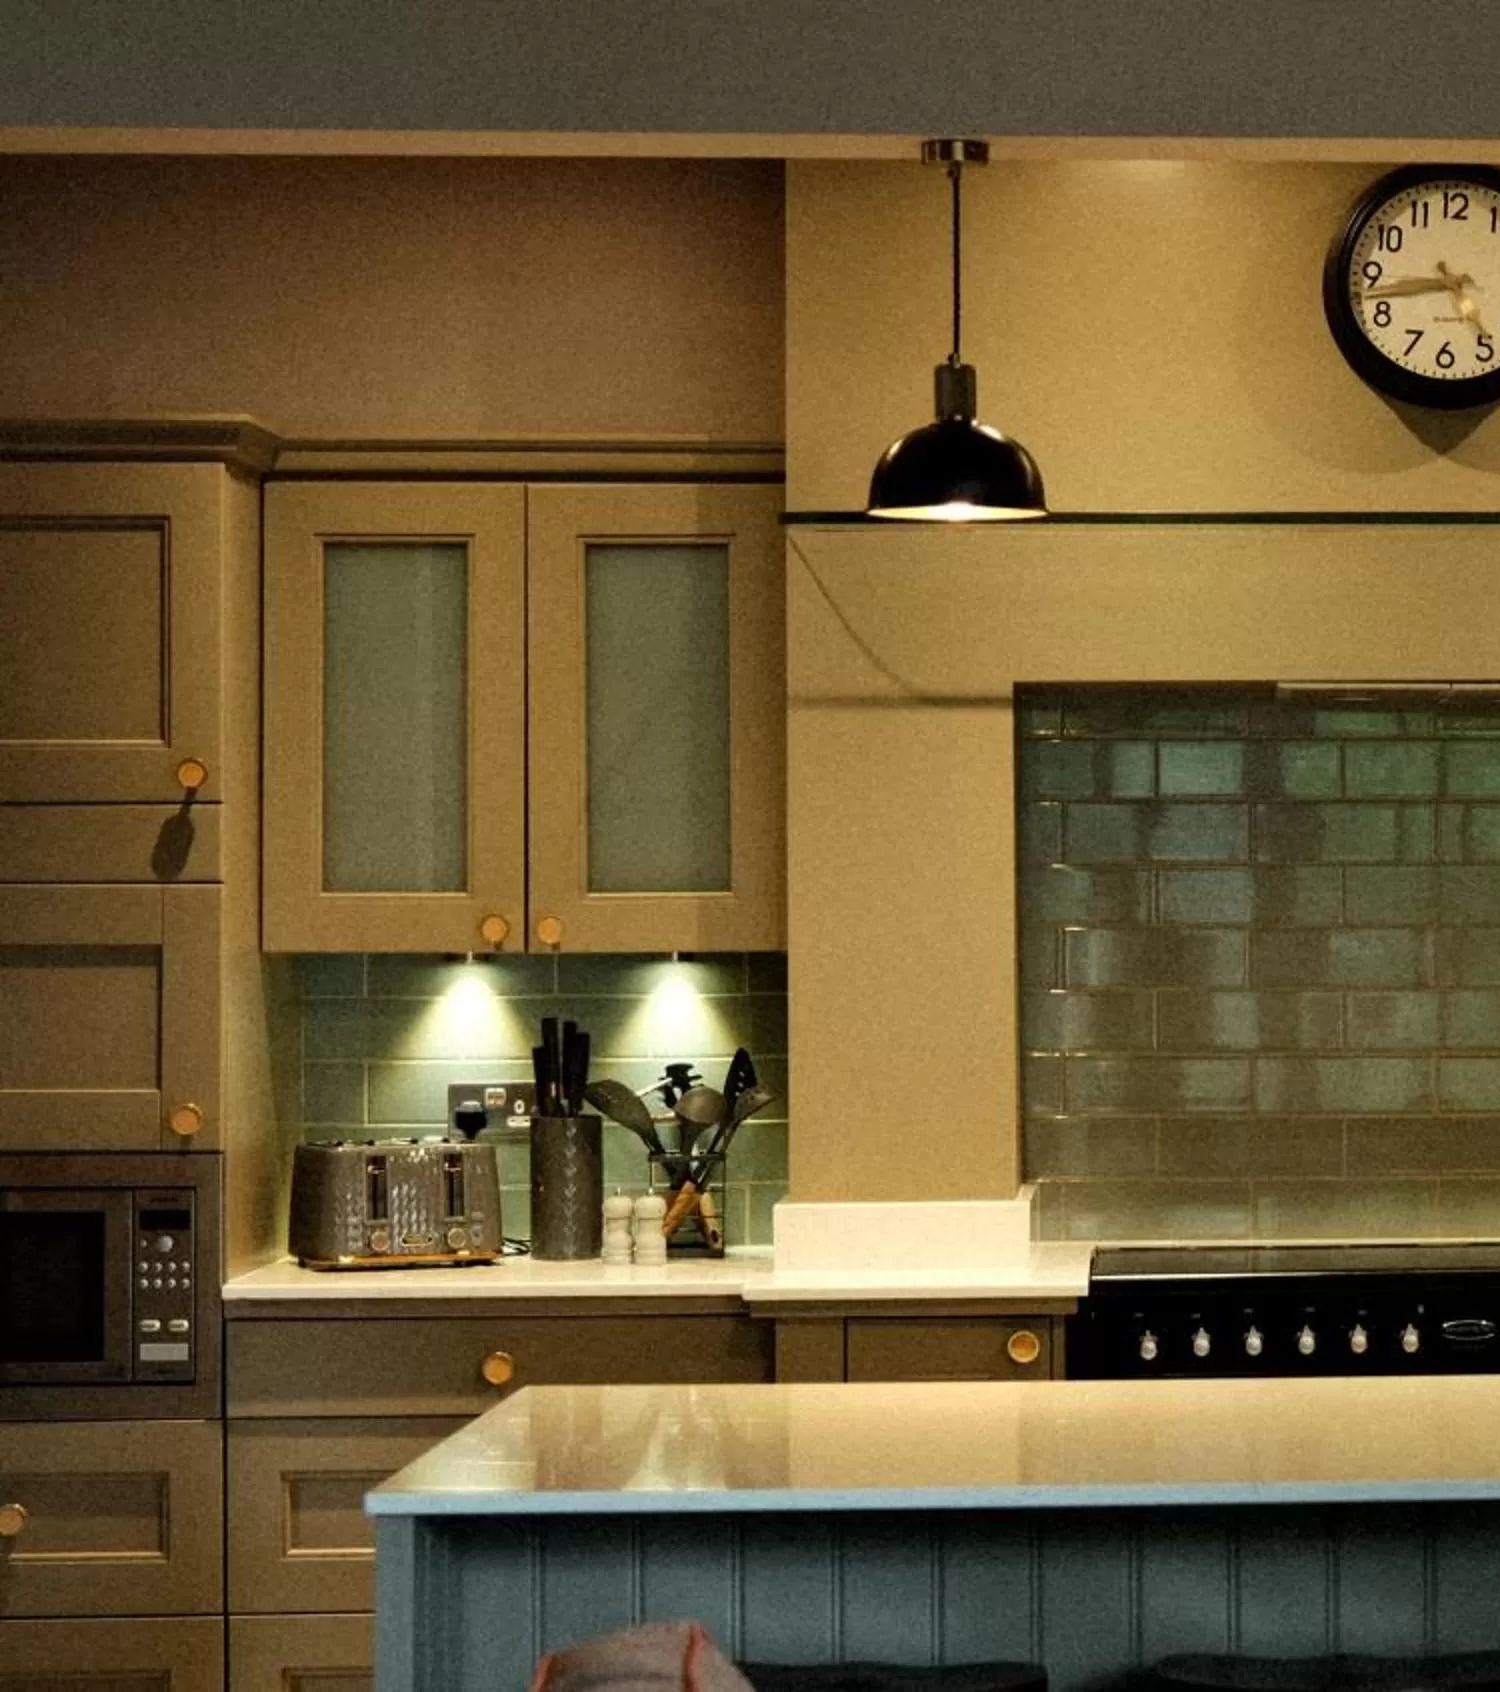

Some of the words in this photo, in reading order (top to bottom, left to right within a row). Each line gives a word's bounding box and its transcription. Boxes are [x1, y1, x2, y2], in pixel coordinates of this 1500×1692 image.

[1411, 201, 1429, 228] 11
[1443, 191, 1468, 220] 12
[1490, 206, 1498, 234] 1
[1378, 223, 1403, 252] 10
[1362, 261, 1382, 288] 9
[1373, 301, 1391, 327] 8
[1403, 329, 1424, 357] 7
[1435, 341, 1455, 368] 6
[1475, 333, 1494, 362] 5
